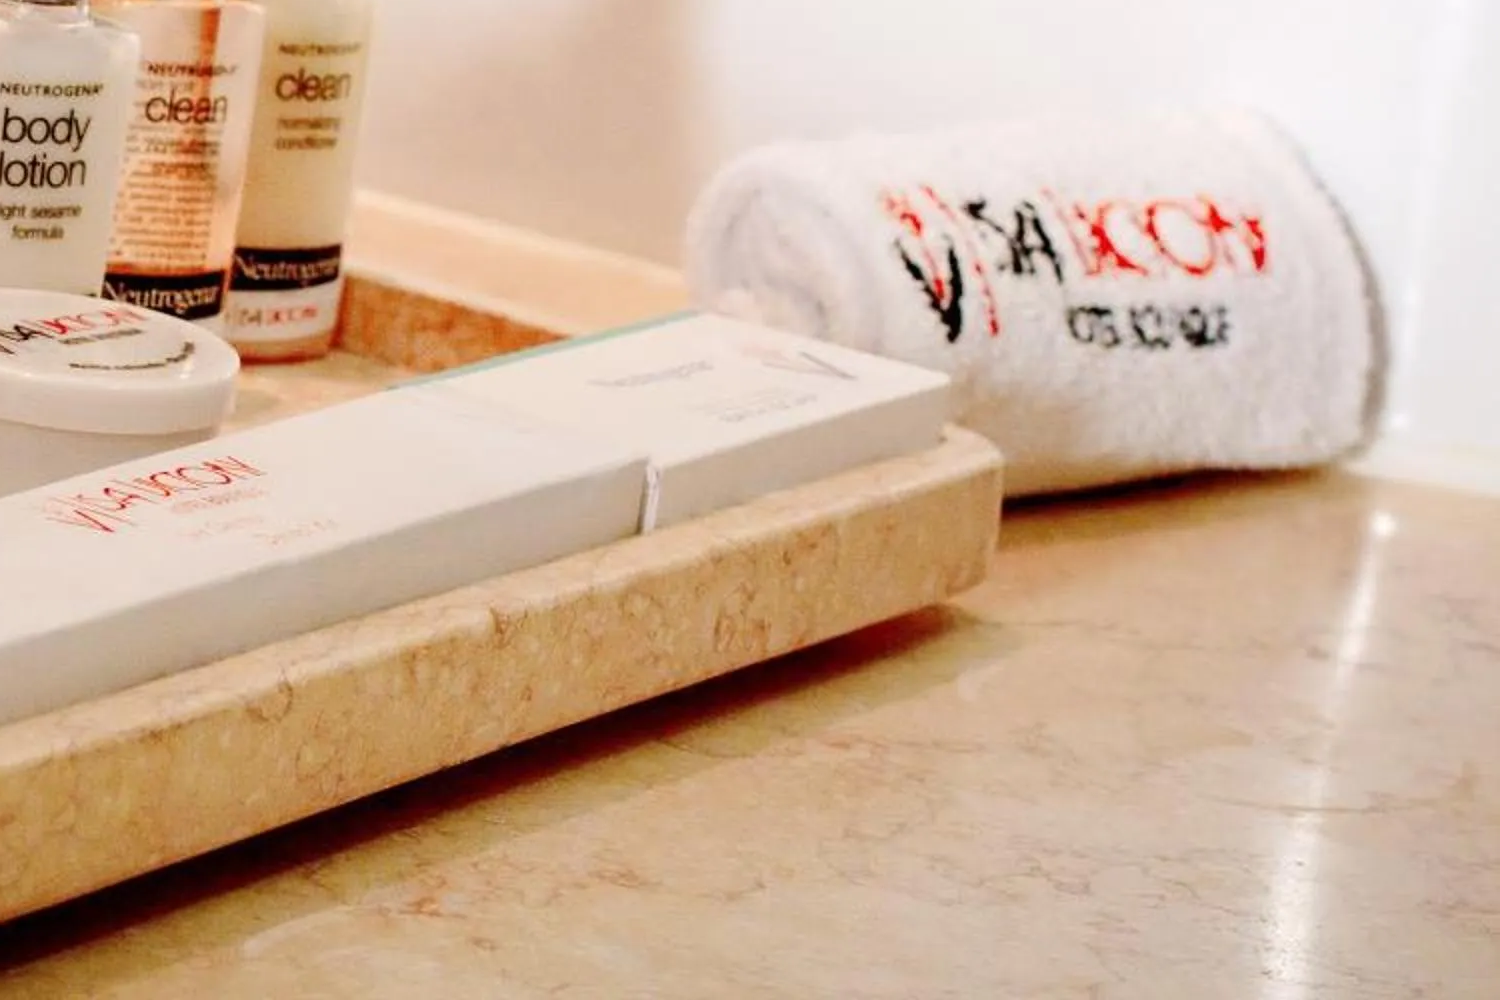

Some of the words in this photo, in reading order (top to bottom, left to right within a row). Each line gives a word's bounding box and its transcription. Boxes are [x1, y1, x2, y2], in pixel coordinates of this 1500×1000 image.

[275, 67, 351, 102] clean
[145, 88, 228, 124] clean
[2, 106, 92, 152] body
